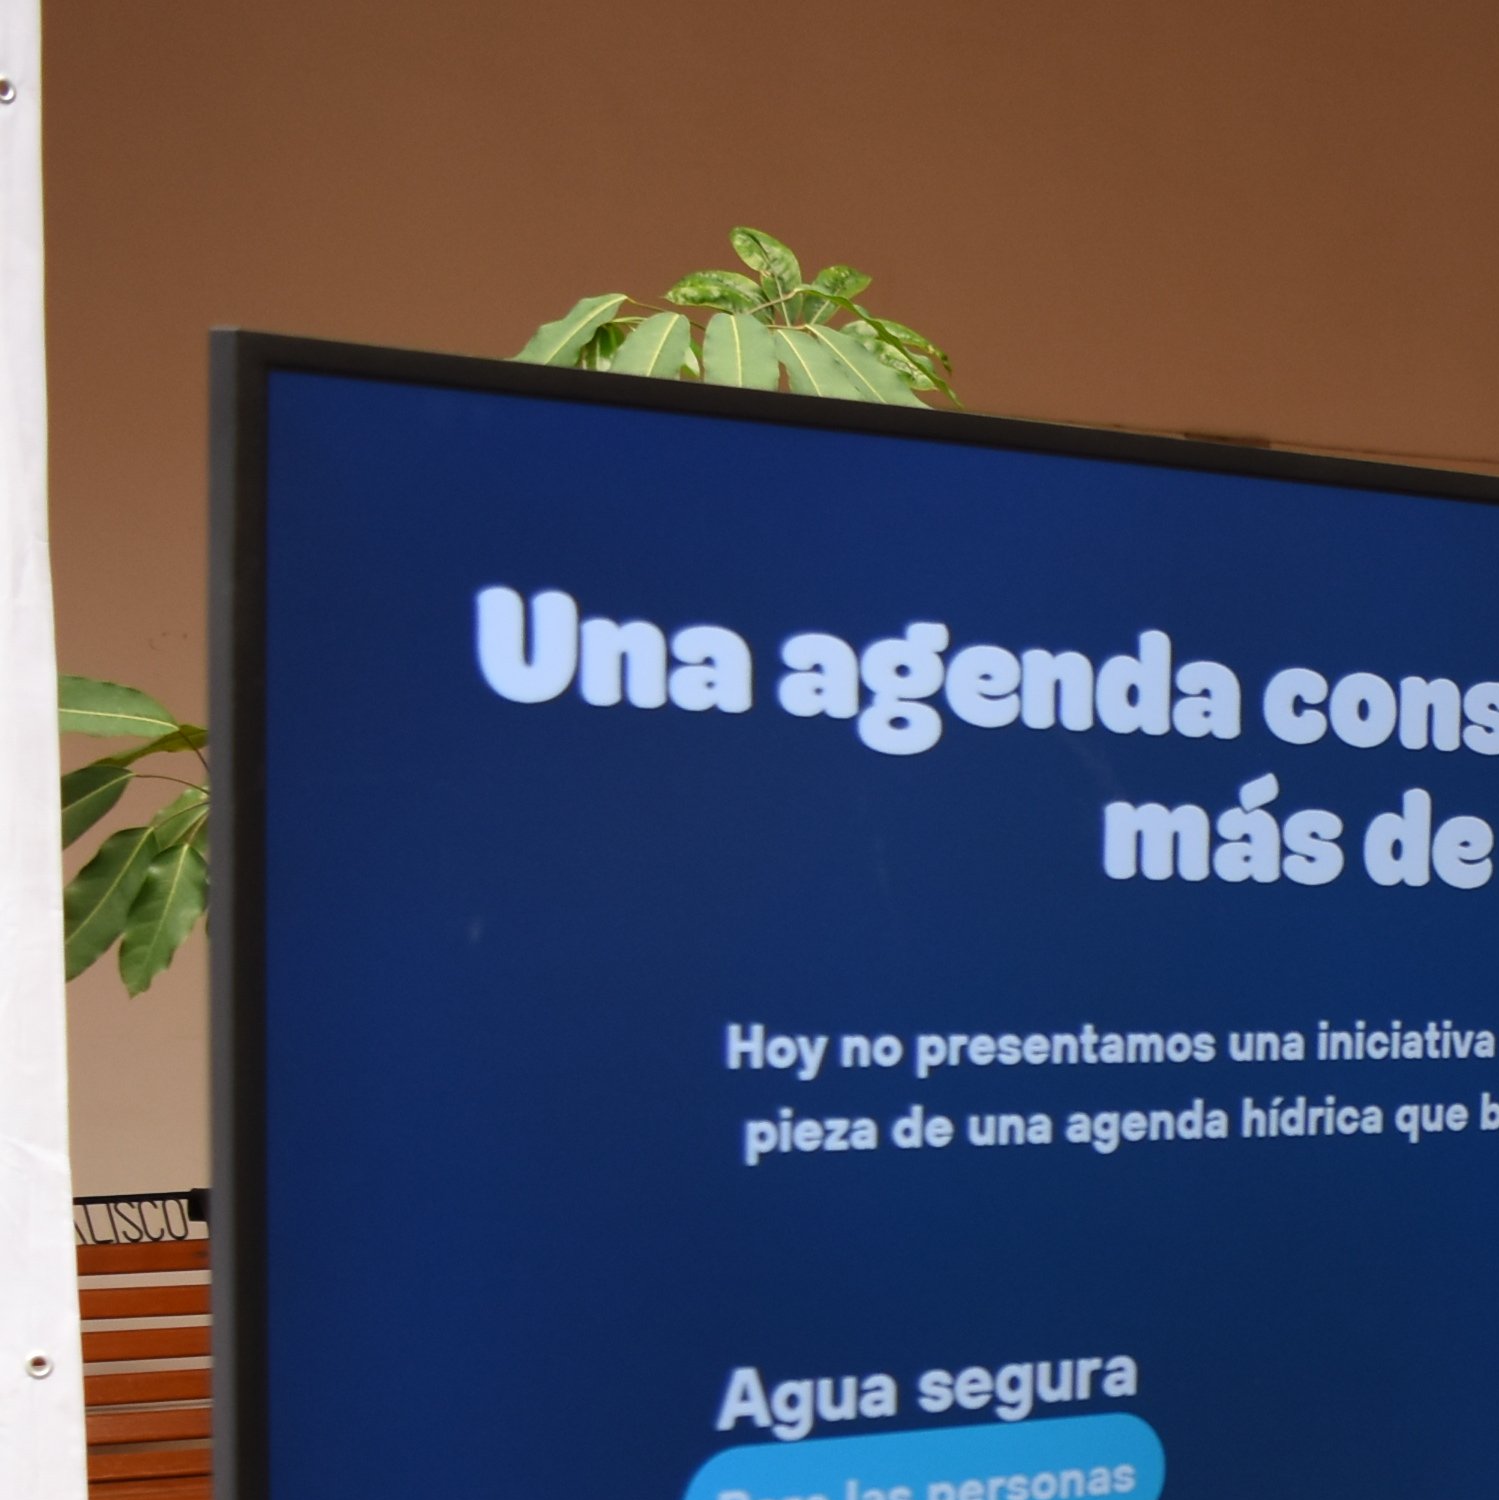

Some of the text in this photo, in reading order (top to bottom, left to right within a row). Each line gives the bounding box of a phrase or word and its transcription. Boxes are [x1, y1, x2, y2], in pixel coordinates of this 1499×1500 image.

[476, 585, 753, 714] Una
[777, 620, 1242, 756] agenda
[1103, 772, 1345, 888] más
[1363, 786, 1495, 890] de
[725, 1022, 830, 1082] Hoy
[840, 1033, 904, 1069] no
[916, 1022, 1217, 1080] presentamos
[1228, 1030, 1306, 1063] una
[1317, 1019, 1496, 1061] iniciativa
[745, 1106, 879, 1167] pieza
[891, 1103, 955, 1150] de
[967, 1112, 1053, 1147] una
[1065, 1097, 1229, 1155] agenda
[1241, 1094, 1384, 1139] hídrica
[1394, 1102, 1470, 1145] que
[716, 1354, 1138, 1442] Agua segura
